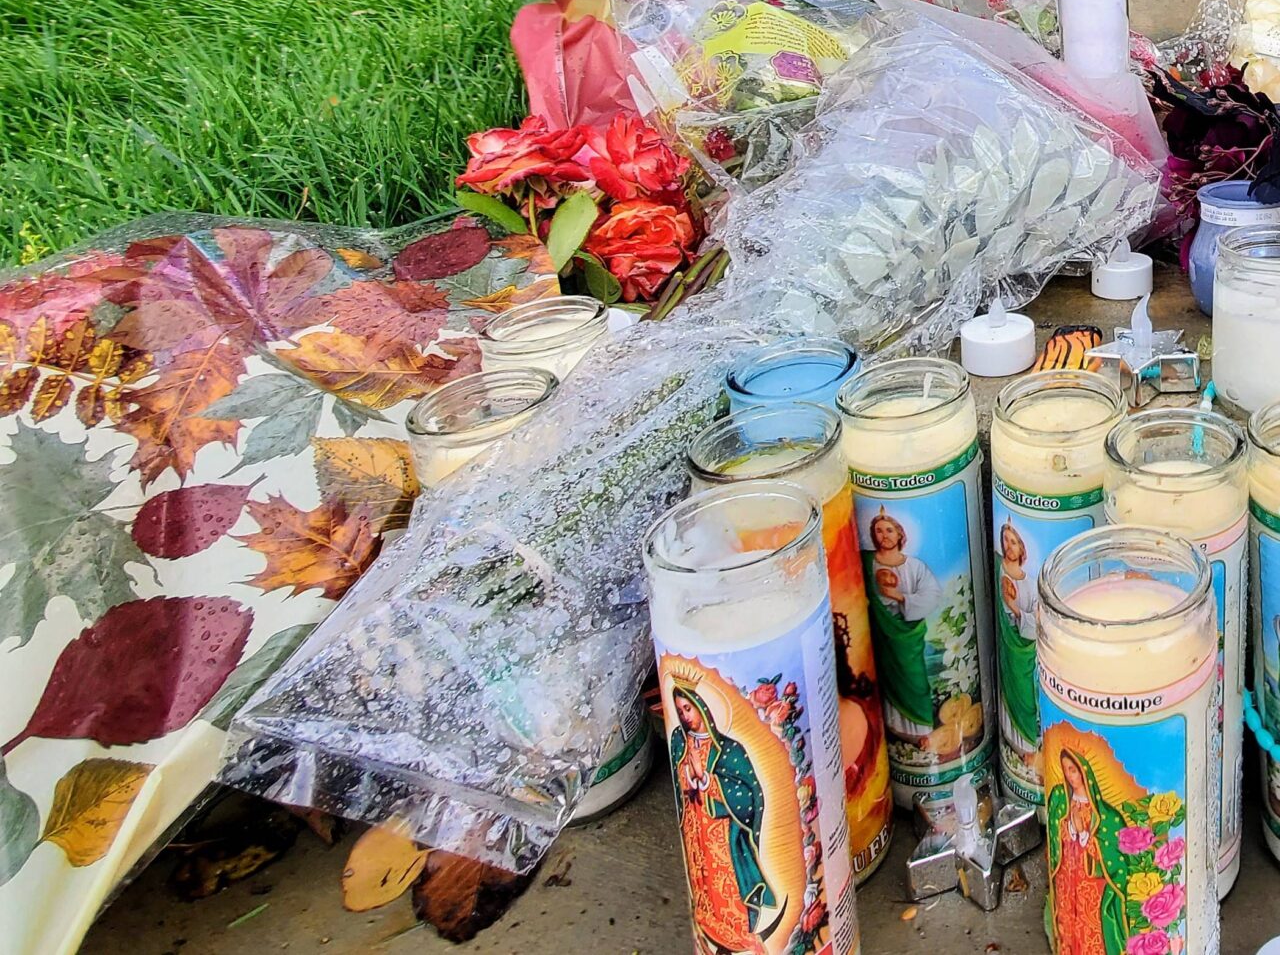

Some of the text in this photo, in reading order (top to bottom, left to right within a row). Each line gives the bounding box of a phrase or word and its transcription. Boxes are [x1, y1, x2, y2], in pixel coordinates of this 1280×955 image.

[854, 472, 935, 490] Judas Tadeo
[1017, 492, 1060, 510] Tadeo
[1049, 675, 1163, 713] de Guadalupe
